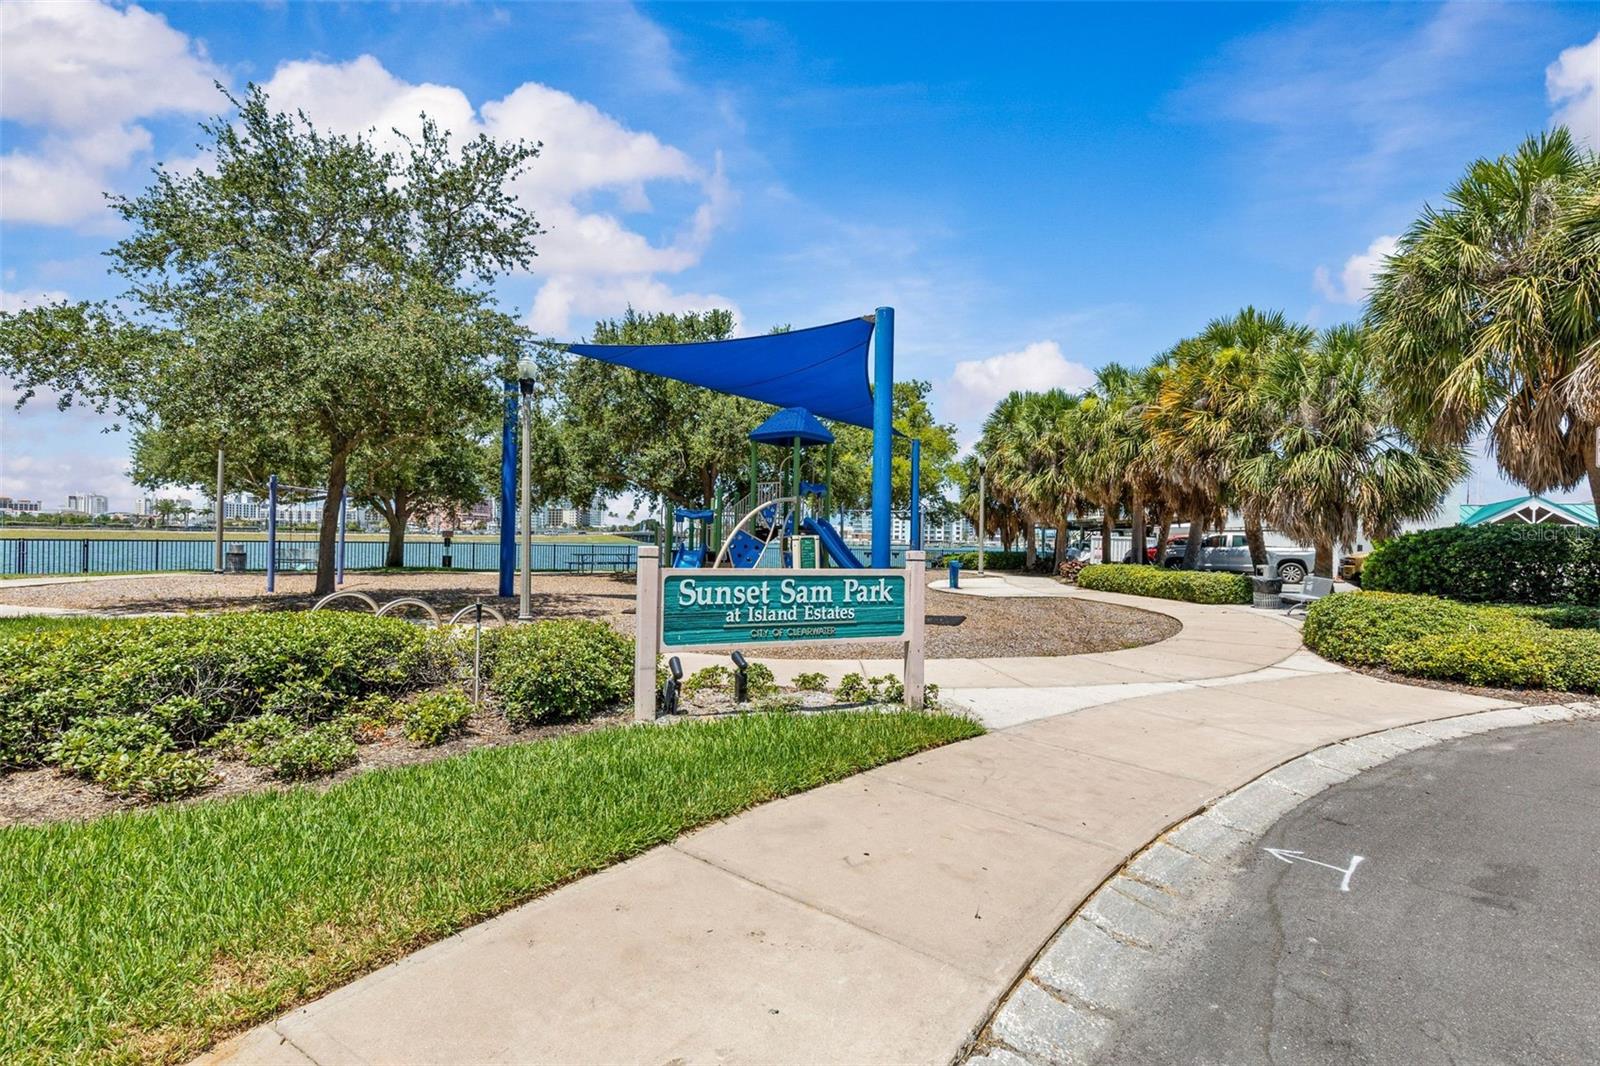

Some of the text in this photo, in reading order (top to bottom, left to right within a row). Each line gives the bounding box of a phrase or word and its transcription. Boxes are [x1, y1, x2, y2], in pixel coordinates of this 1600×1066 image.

[679, 577, 893, 606] Sunset Sam Park
[725, 604, 855, 623] at Island Estates
[750, 626, 836, 638] CITY OF CLEARWATER
